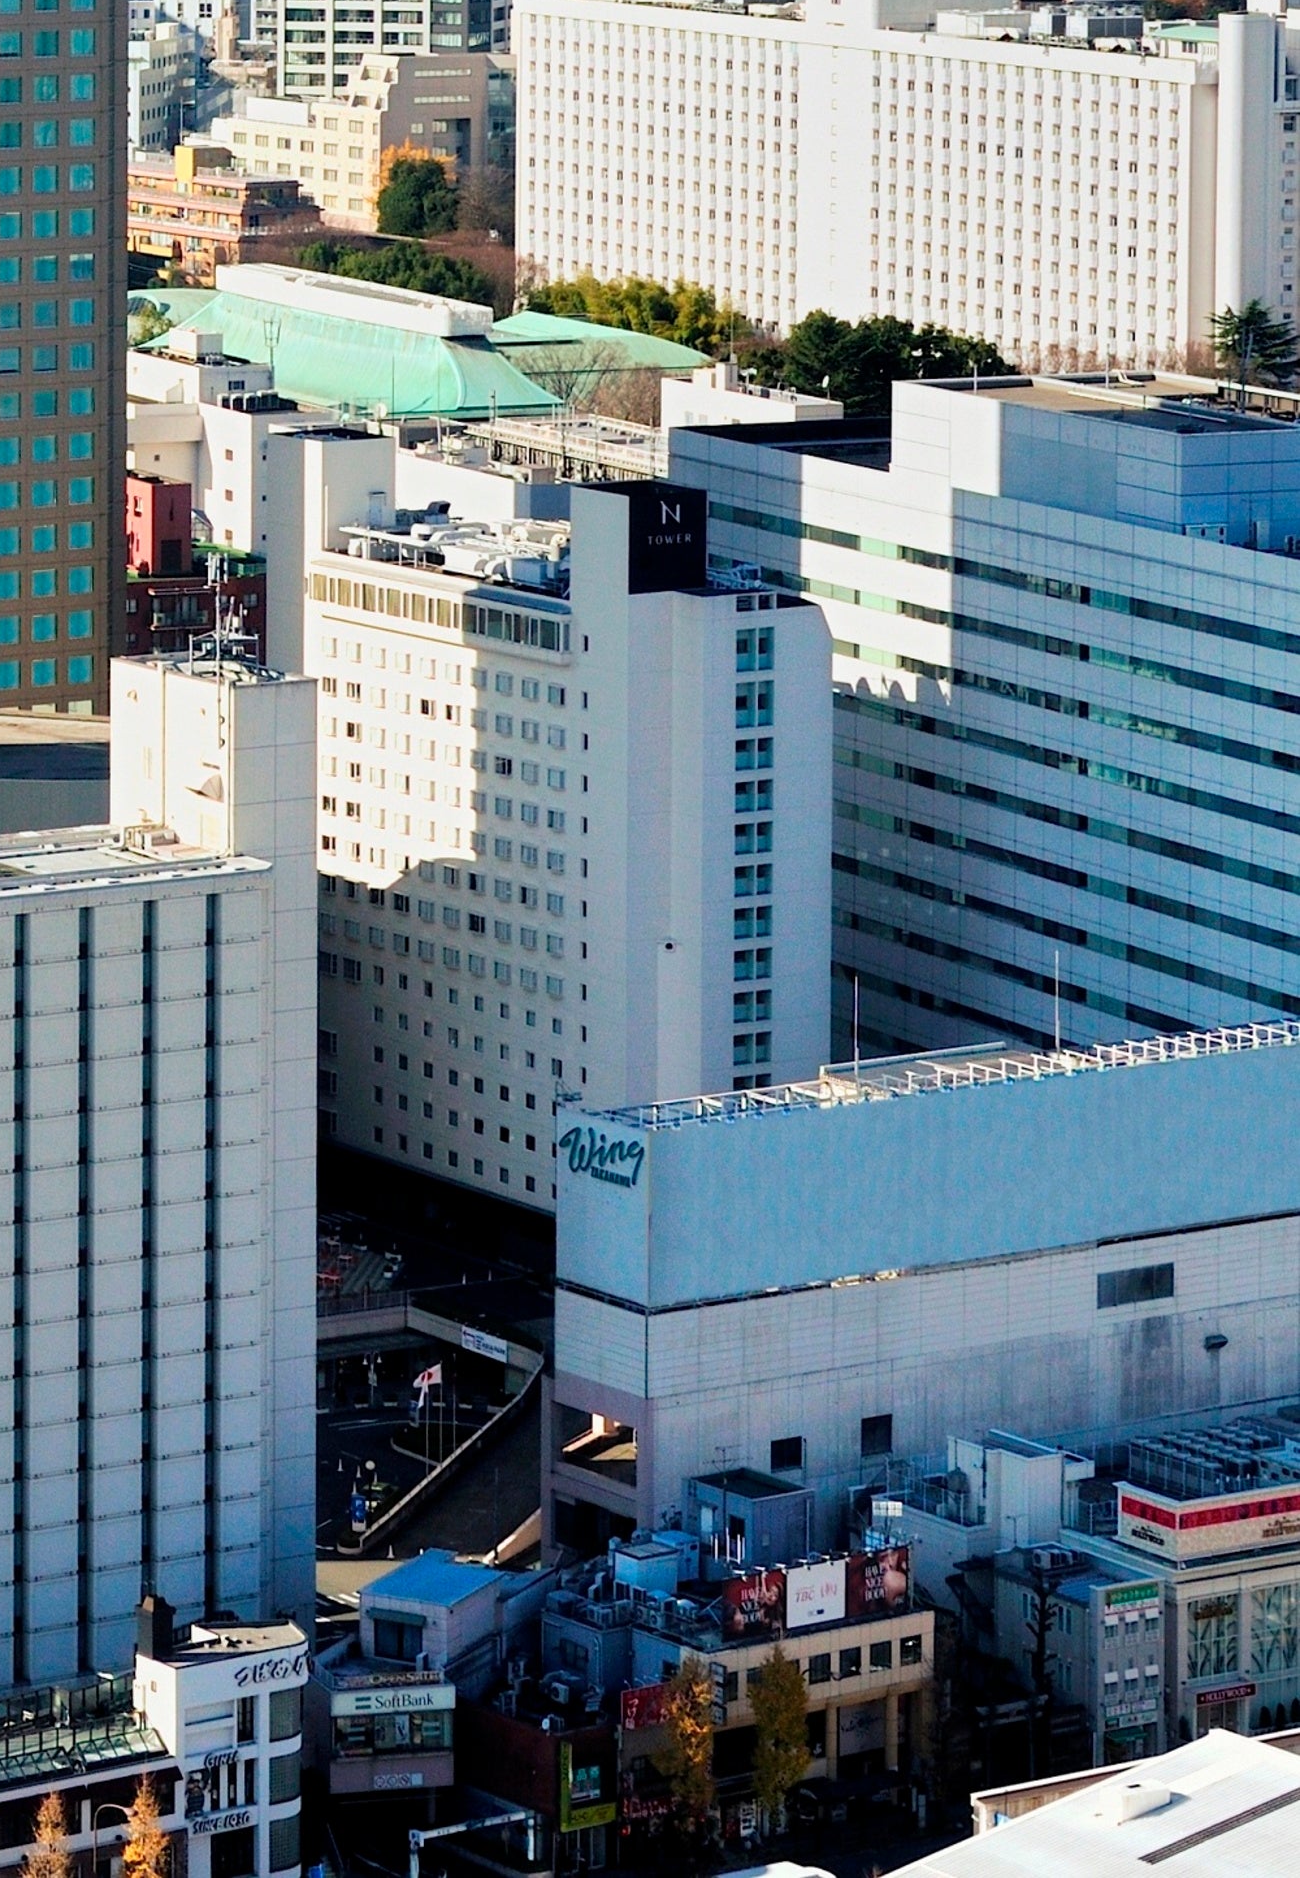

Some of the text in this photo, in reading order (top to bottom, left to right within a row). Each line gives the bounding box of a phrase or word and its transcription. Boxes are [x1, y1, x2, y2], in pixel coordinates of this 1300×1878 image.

[659, 500, 681, 526] N
[648, 533, 692, 545] TOWER
[558, 1126, 645, 1187] Wing
[374, 1692, 434, 1710] SoftBank
[1205, 1686, 1248, 1703] HOLLYWOOD
